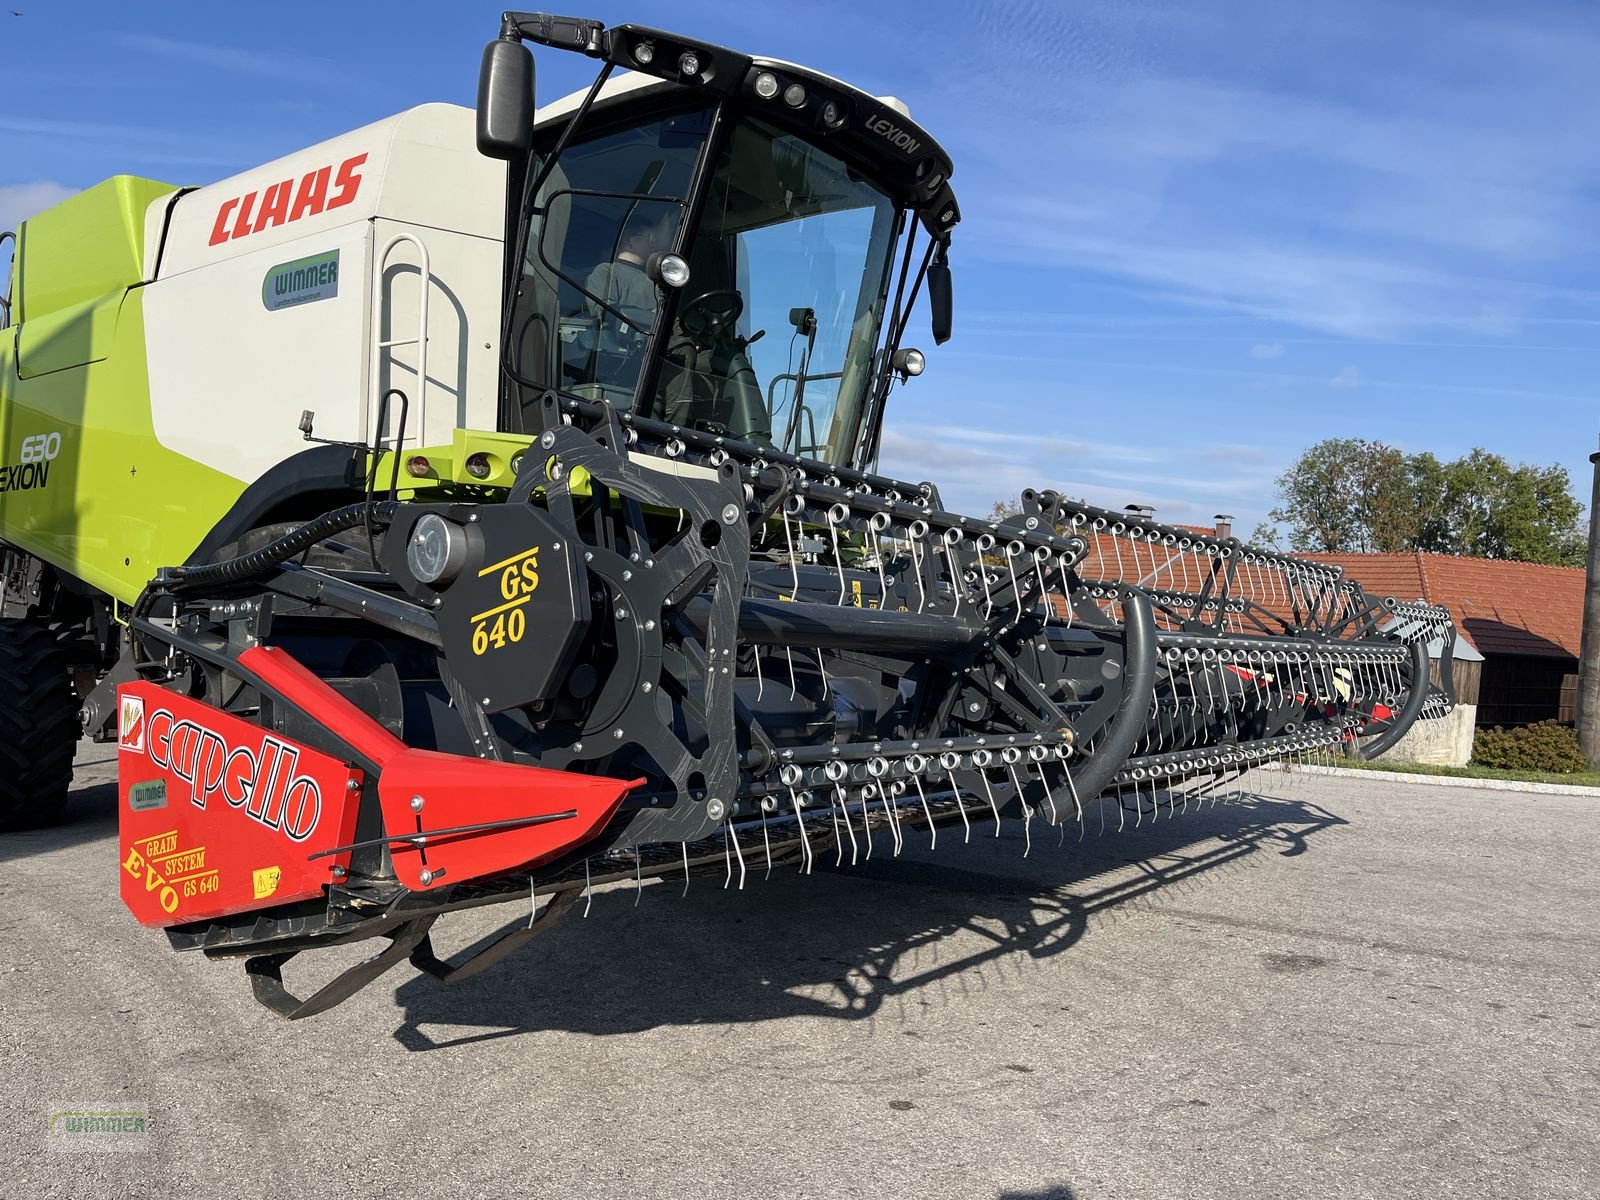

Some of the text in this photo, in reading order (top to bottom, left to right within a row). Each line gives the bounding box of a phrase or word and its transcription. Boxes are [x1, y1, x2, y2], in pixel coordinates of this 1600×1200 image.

[864, 114, 920, 154] LEXION
[208, 152, 369, 247] CLAAS
[275, 261, 337, 295] WIMMER
[20, 431, 61, 464] 630
[0, 461, 50, 492] EXION
[501, 556, 539, 600] GS
[472, 608, 525, 655] 640
[135, 785, 166, 802] WIMMER
[146, 835, 178, 857] GRAIN
[165, 851, 205, 876] SYSTEM
[122, 847, 179, 914] EVO
[183, 875, 219, 897] GS 640
